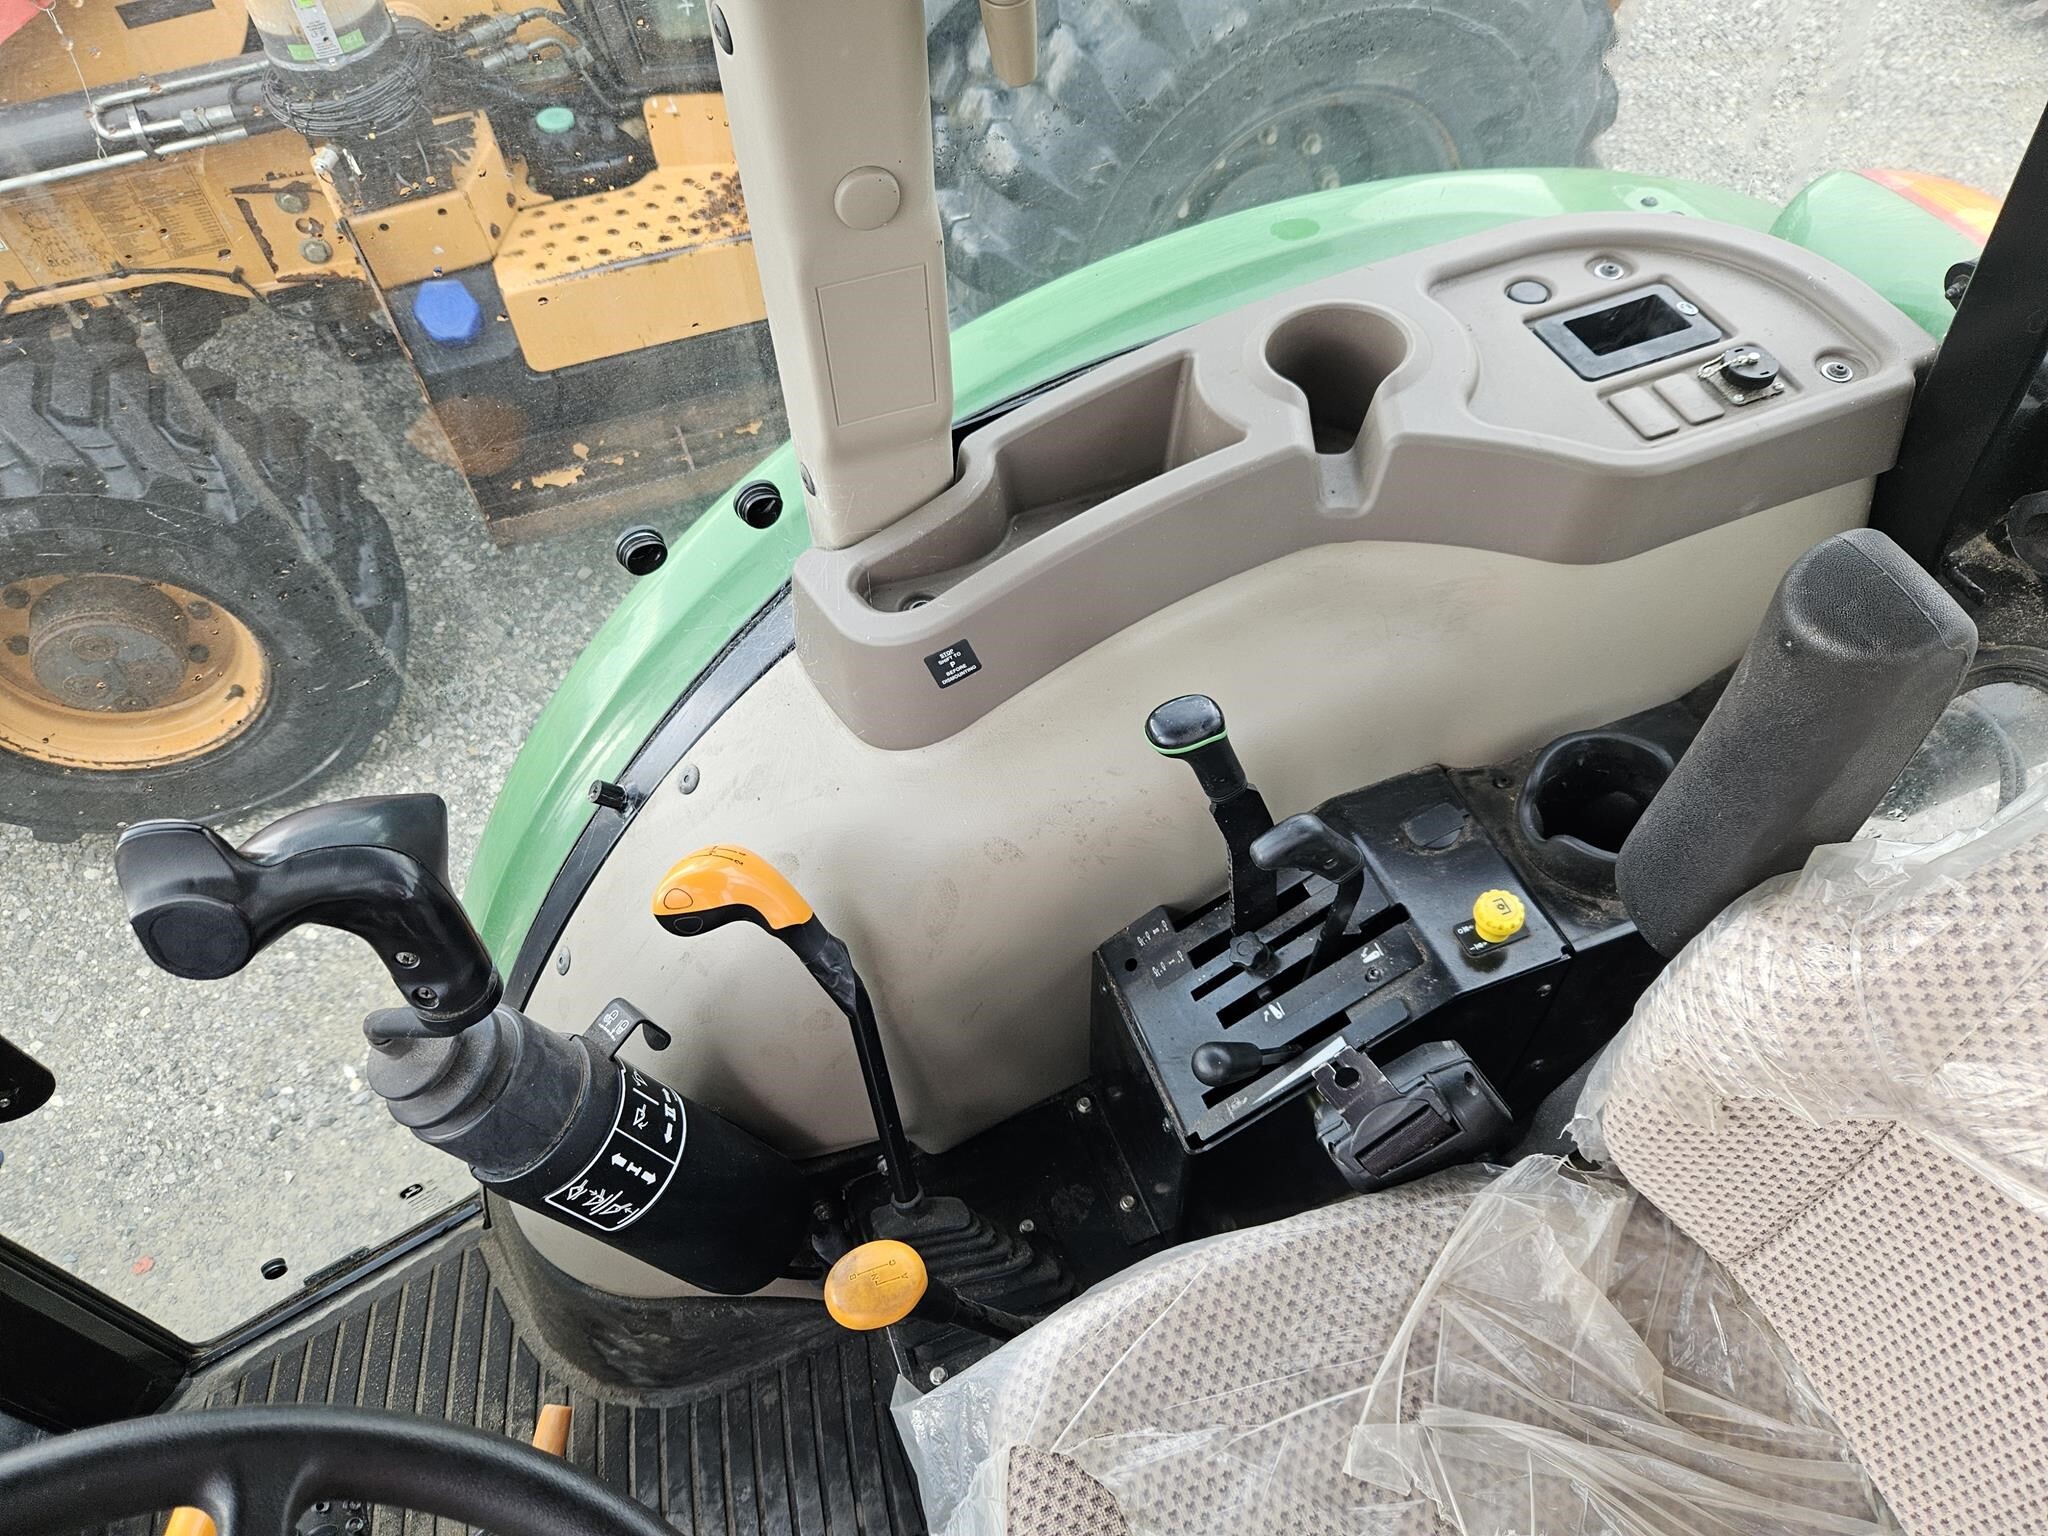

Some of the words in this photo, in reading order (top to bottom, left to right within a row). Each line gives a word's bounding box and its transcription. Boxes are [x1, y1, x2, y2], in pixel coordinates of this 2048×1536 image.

[939, 649, 954, 659] STOP
[938, 656, 953, 665] SHIFT
[942, 665, 976, 684] DISMOUNTING
[946, 664, 967, 676] BEFORE
